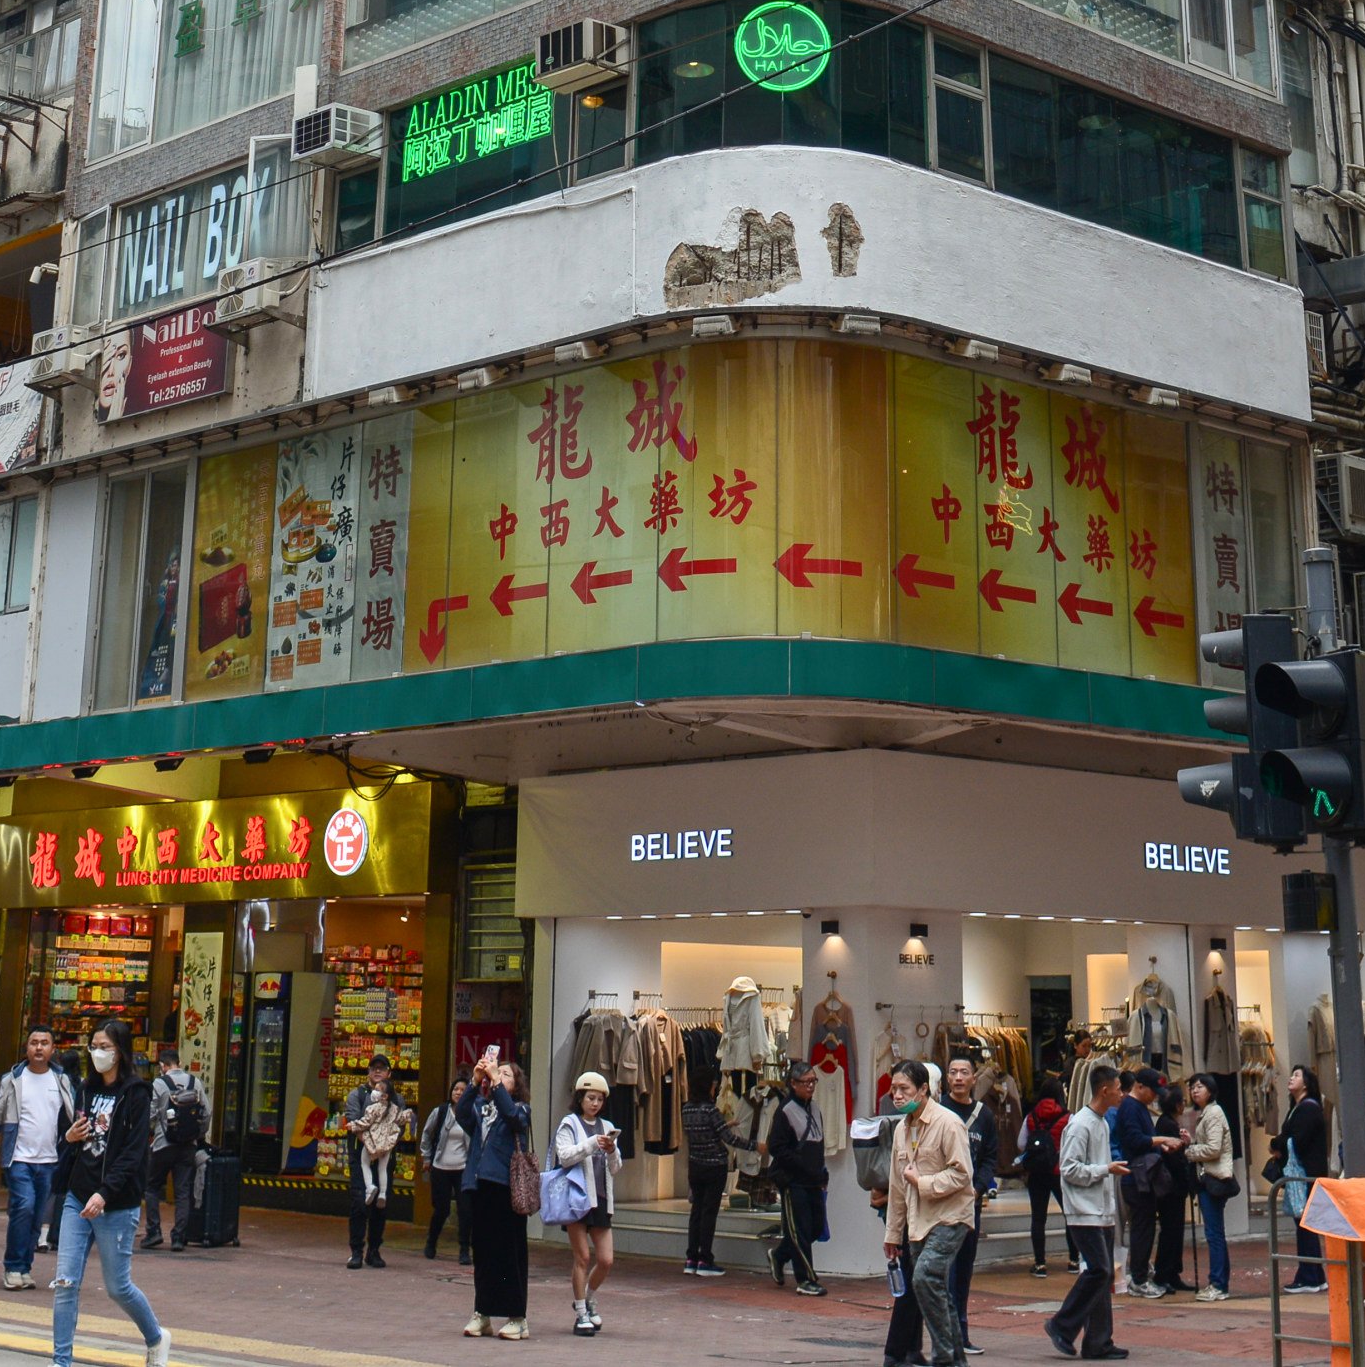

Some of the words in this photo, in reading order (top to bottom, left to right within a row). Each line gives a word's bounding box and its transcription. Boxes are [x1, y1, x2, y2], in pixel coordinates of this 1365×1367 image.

[755, 60, 810, 72] HALAL
[405, 80, 489, 138] ALADIN
[495, 62, 549, 107] MES
[403, 91, 552, 182] 阿拉丁咖喱屋
[119, 195, 185, 309] NAIL
[203, 167, 270, 279] BOX
[160, 343, 192, 357] Professional
[193, 337, 204, 348] Nail
[178, 354, 183, 363] &
[147, 372, 168, 384] Eyelash
[169, 365, 193, 378] extension
[194, 357, 213, 371] Beauty
[149, 377, 207, 404] Tel:25766557
[528, 359, 698, 484] 龍城
[966, 381, 1120, 514] 龍城
[489, 469, 757, 561] 中西大藥坊
[931, 483, 1158, 580] 中西大藥坊
[361, 444, 403, 651] 特賣場
[30, 815, 313, 888] 龍城中西大藥坊
[334, 836, 355, 866] 正
[631, 828, 733, 862] BELIEVE
[1144, 841, 1231, 875] BELIEVE
[116, 870, 149, 886] LUNG
[150, 868, 178, 885] CITY
[180, 865, 241, 884] MEDICINE
[243, 862, 310, 880] COMPANY
[899, 954, 934, 965] BELIEVE
[321, 1018, 332, 1046] Bull
[318, 1050, 331, 1080] Red
